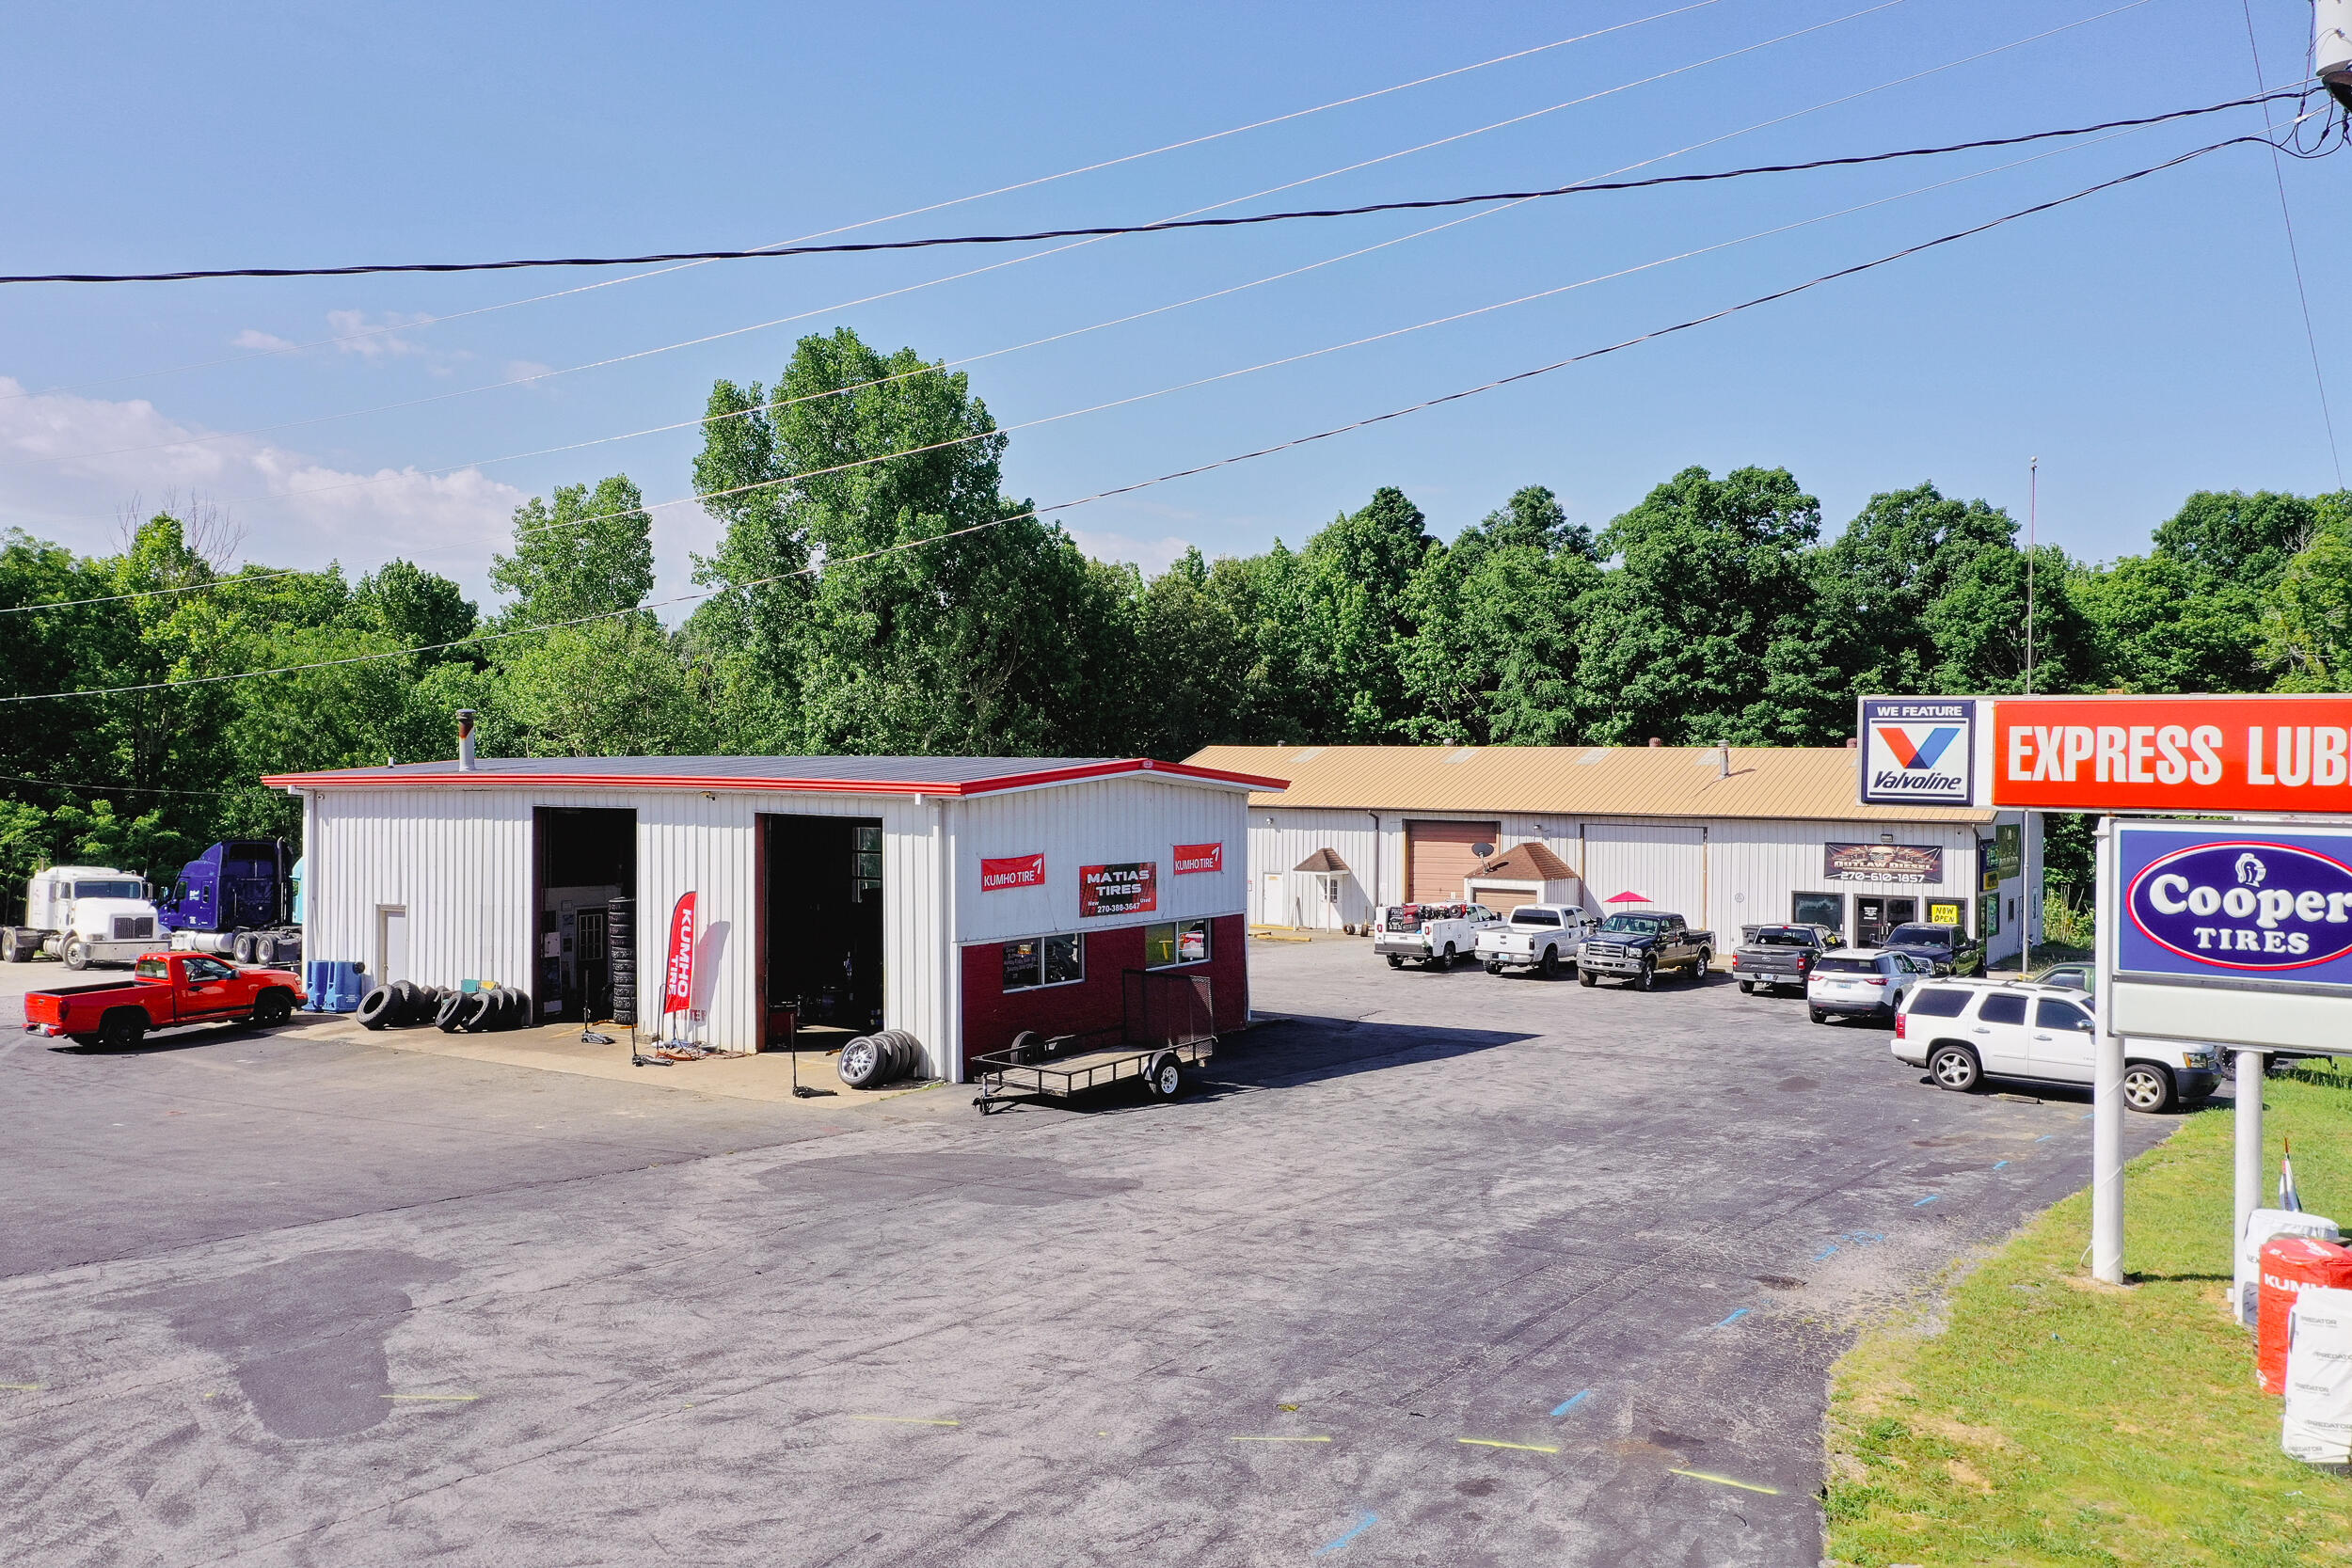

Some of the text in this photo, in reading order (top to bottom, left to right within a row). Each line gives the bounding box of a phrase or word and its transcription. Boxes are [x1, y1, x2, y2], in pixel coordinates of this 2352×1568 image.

[1877, 706, 1963, 717] WE FEATURE
[2008, 725, 2352, 786] EXPRESS LUB
[1874, 771, 1962, 790] Valvoline
[1175, 857, 1214, 871] KUMHO TIRE
[1835, 861, 1885, 869] OUTLAW
[1888, 863, 1933, 871] DIESEL
[984, 870, 1035, 887] KUMHO TIRE
[1087, 870, 1150, 884] MATIAS
[1841, 871, 1925, 882] 270-610-1857
[1096, 883, 1142, 896] TIRES
[1097, 902, 1140, 913] 270-388-3647
[2149, 873, 2352, 928] Cooper
[2193, 927, 2310, 954] TIRES
[677, 909, 692, 998] KUMHO
[669, 955, 678, 995] TIRE
[2264, 1273, 2328, 1293] KUM
